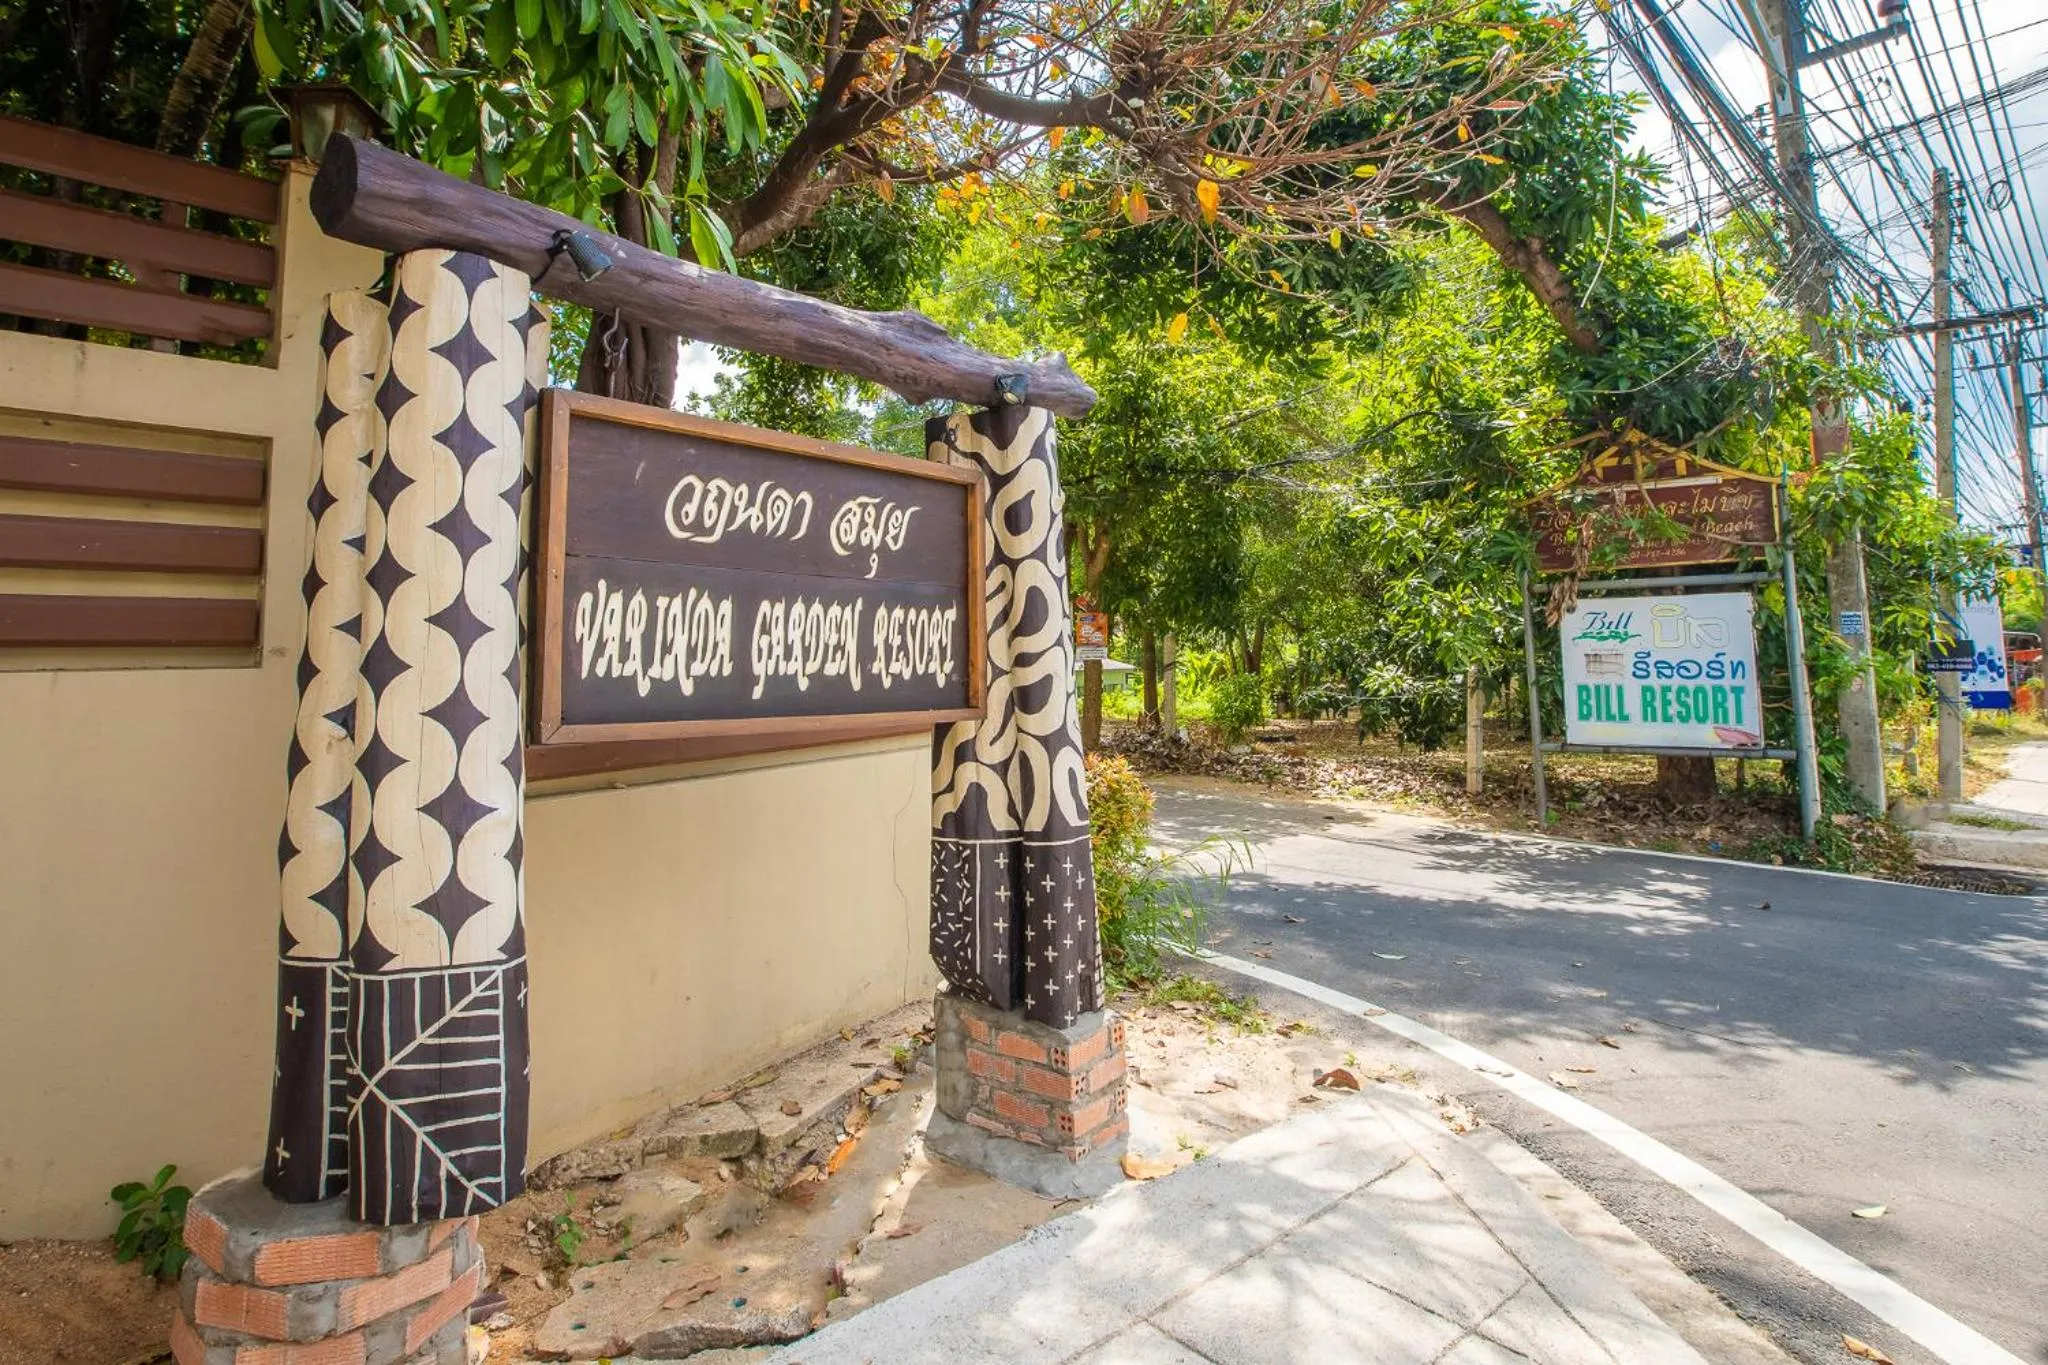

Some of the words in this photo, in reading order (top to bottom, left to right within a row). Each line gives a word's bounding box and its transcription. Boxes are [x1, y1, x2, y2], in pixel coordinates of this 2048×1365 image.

[830, 495, 923, 579] สมุย
[575, 579, 733, 697] VARINDA
[751, 596, 863, 699] GARDEN
[872, 600, 957, 689] RESORT
[1583, 611, 1634, 630] Bill
[1651, 603, 1730, 648] บิล
[1632, 650, 1746, 680] รีสอร์ท
[1577, 684, 1630, 722] BILL
[1640, 685, 1746, 725] RESORT
